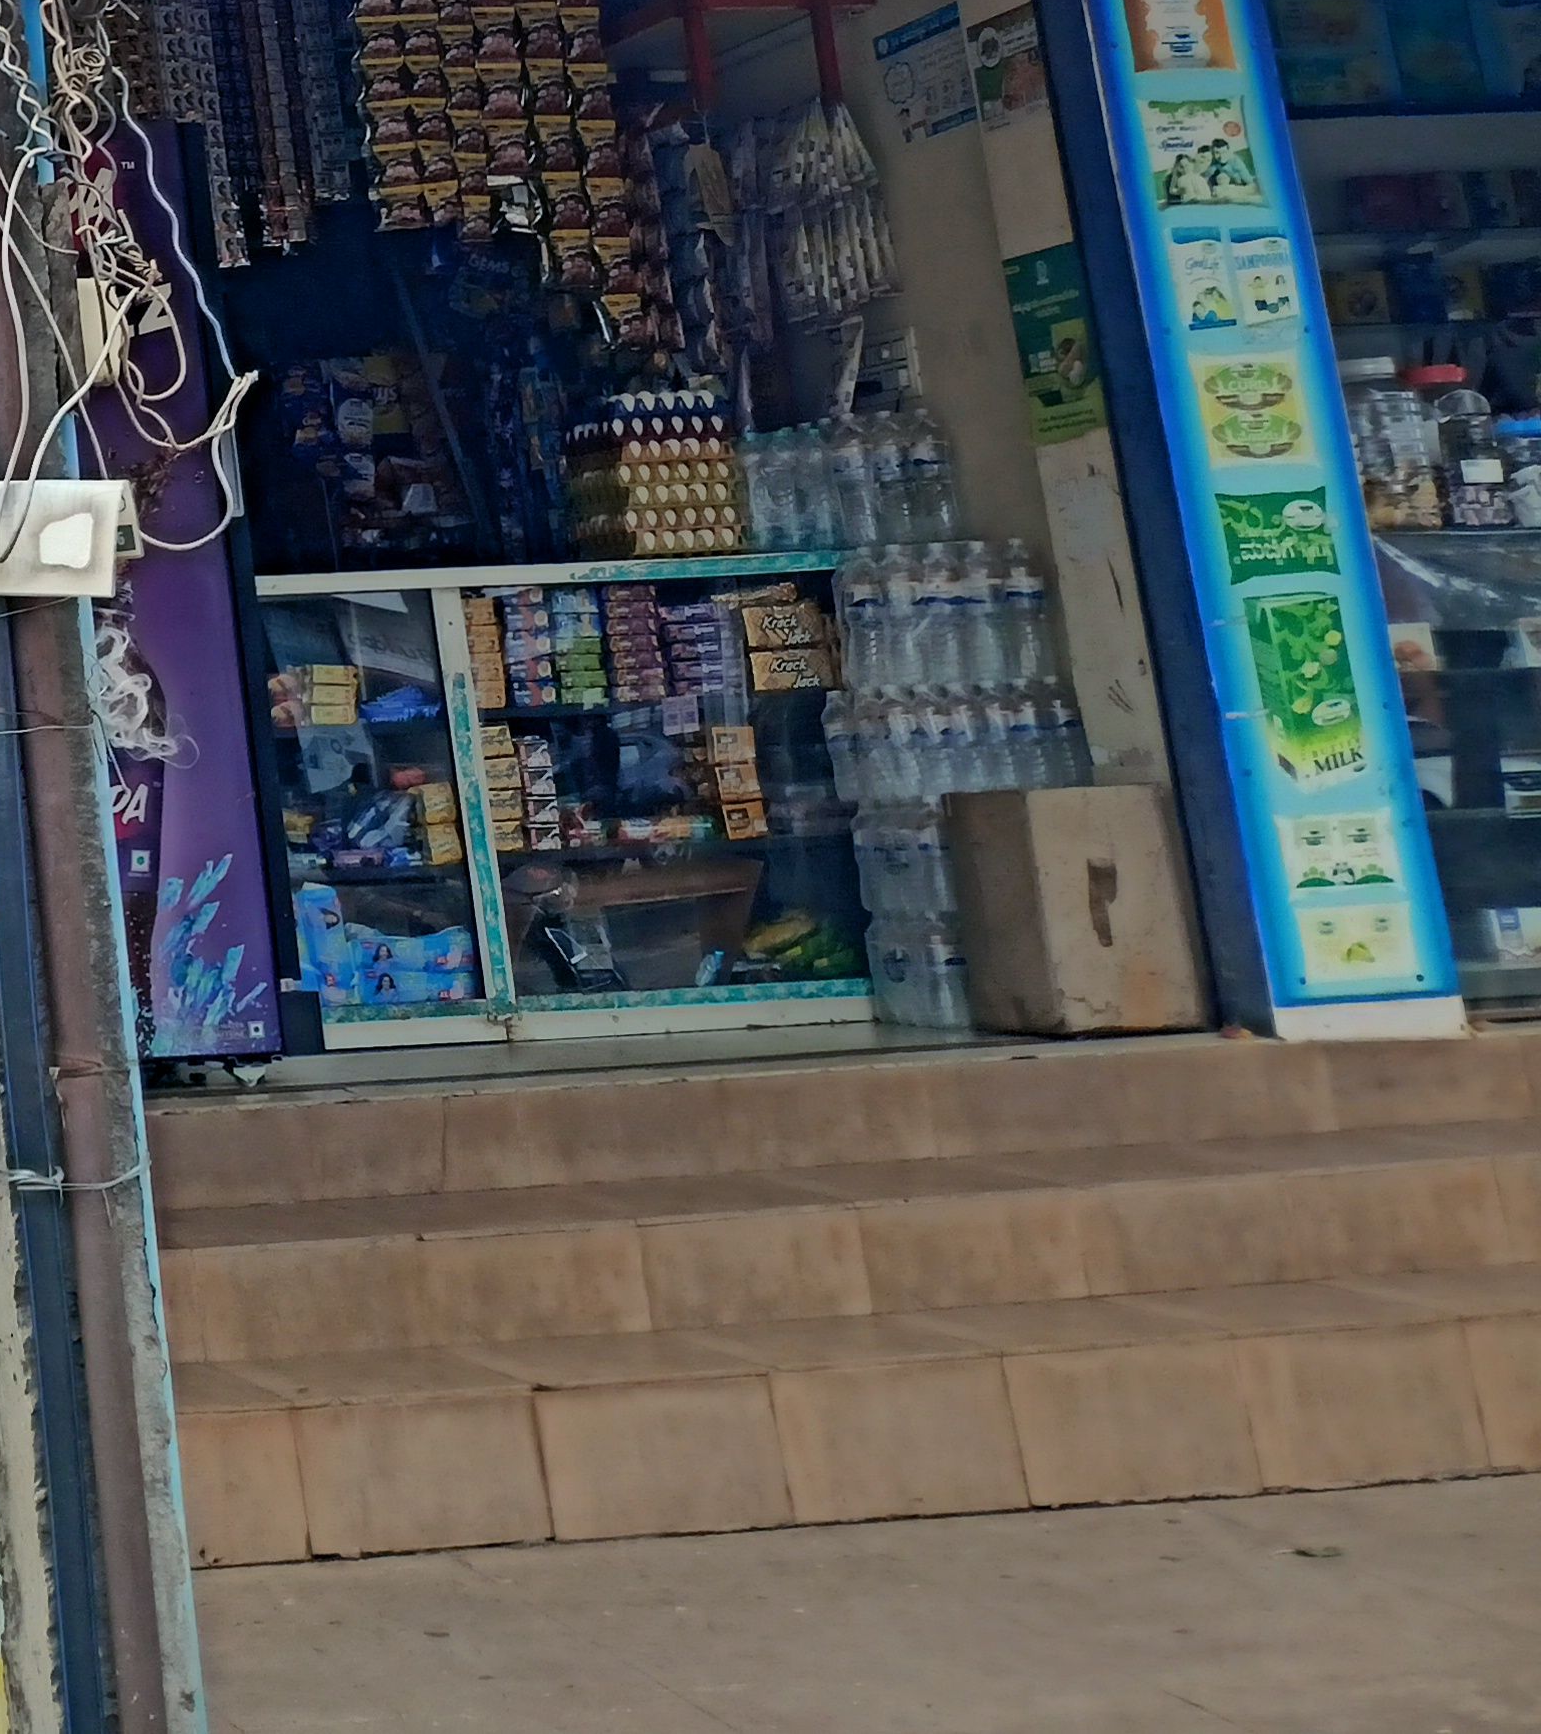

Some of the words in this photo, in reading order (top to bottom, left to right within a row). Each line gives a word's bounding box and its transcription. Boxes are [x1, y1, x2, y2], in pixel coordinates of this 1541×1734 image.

[762, 615, 797, 630] Krack
[770, 658, 807, 673] Krack
[1313, 746, 1365, 775] MILK
